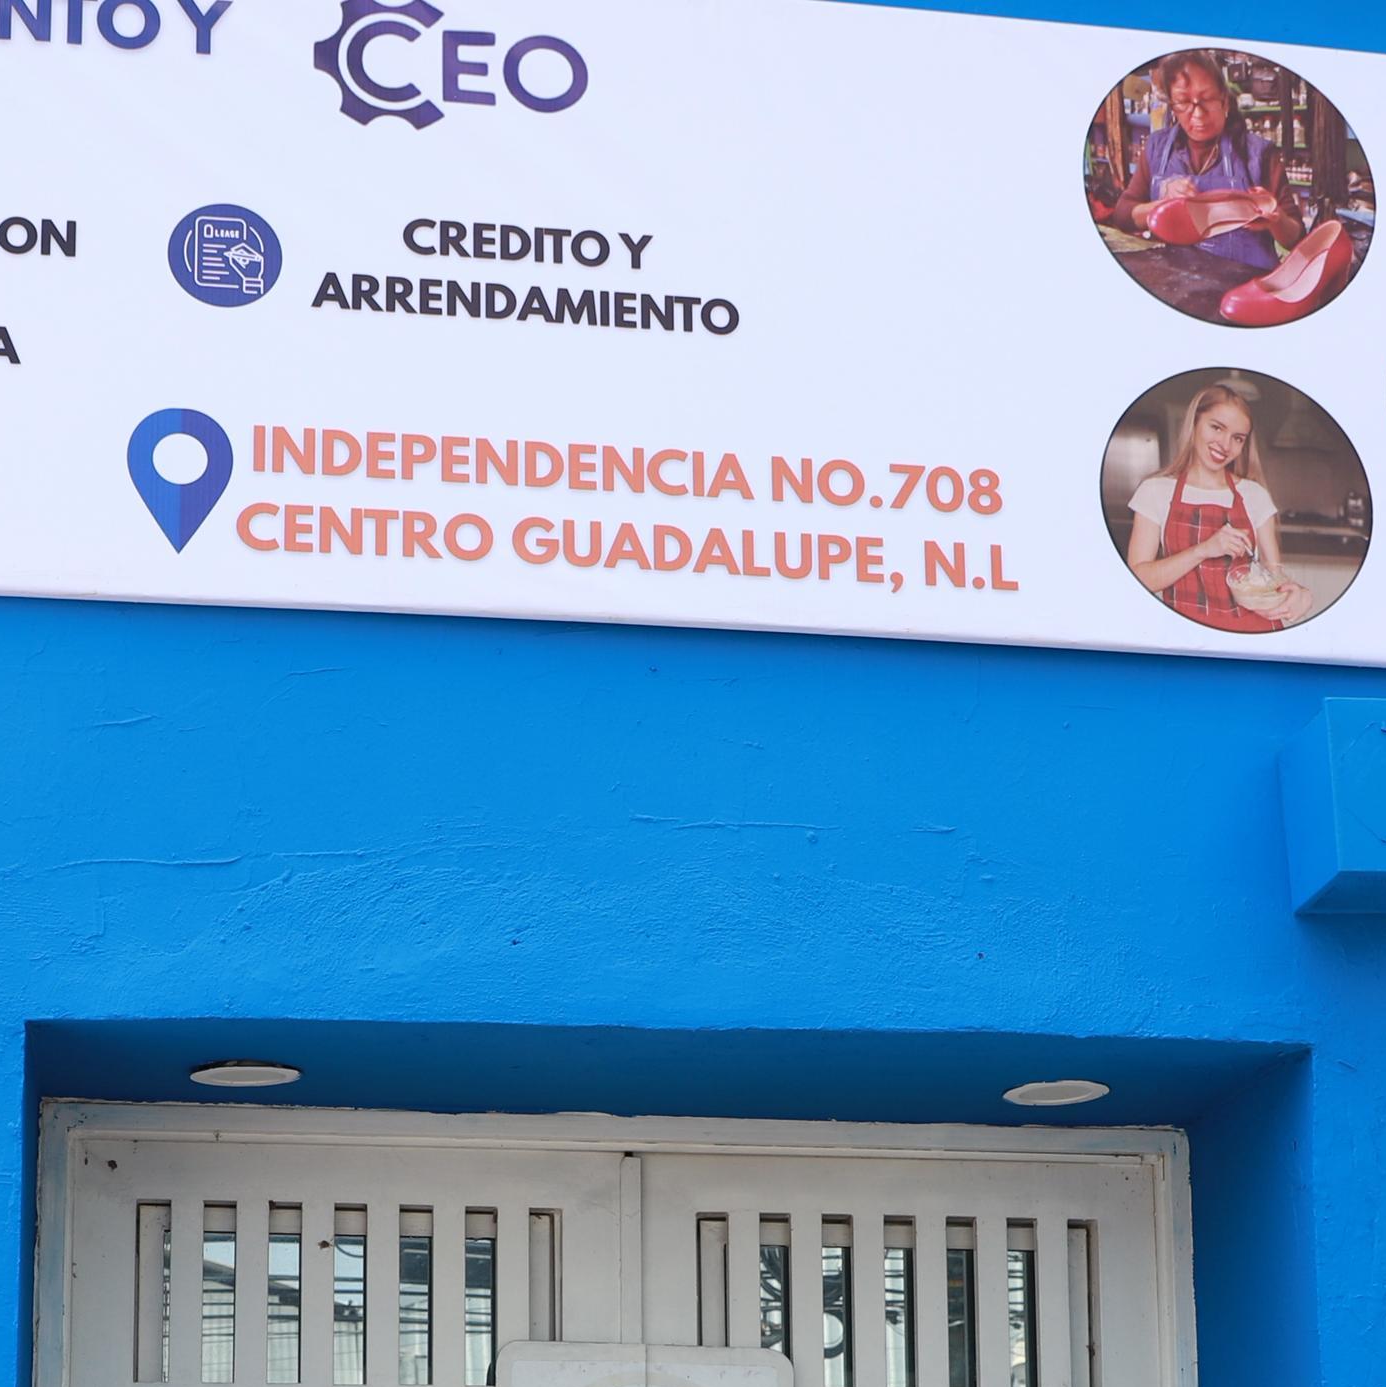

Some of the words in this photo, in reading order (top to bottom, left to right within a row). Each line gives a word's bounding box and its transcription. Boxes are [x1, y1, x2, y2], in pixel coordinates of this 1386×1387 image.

[177, 0, 232, 55] Y
[346, 20, 588, 113] CEO
[215, 229, 239, 238] LEASE
[403, 218, 610, 267] CREDITO
[618, 233, 653, 269] Y
[311, 272, 739, 335] ARRENDAMIENTO
[253, 426, 754, 500] INDEPENDENCIA
[772, 456, 1002, 515] NO.708
[237, 503, 493, 561] CENTRO
[512, 517, 903, 593] GUADALUPE,
[924, 541, 1018, 591] N.L
